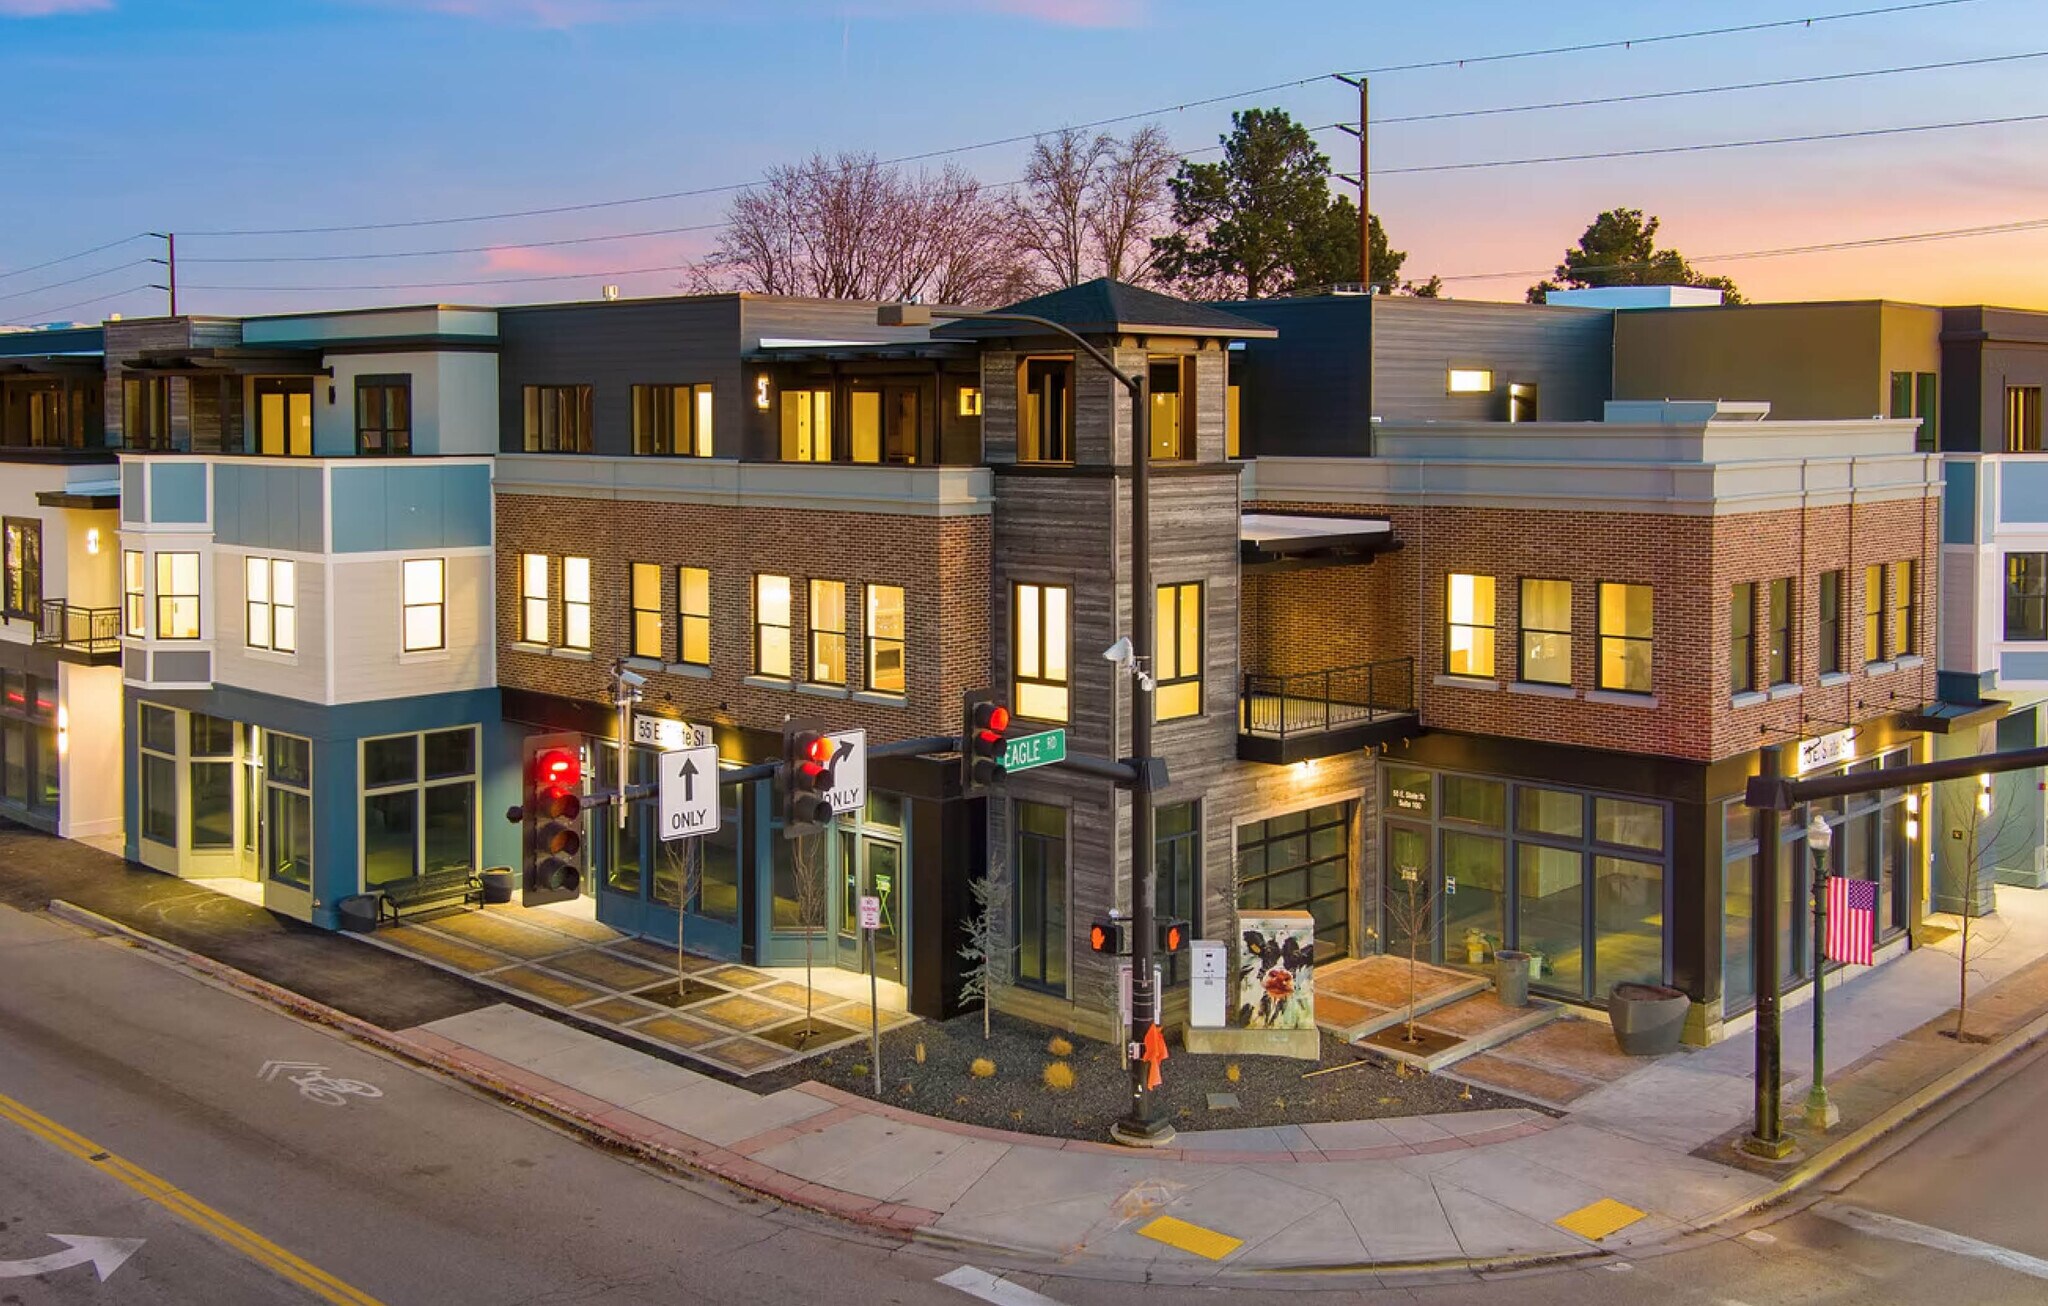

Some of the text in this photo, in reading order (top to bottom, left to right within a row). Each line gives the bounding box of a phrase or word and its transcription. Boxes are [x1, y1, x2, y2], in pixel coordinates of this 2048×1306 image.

[639, 720, 652, 739] 55
[694, 729, 705, 746] St
[1004, 735, 1058, 767] EAGLE RD
[671, 808, 708, 831] ONLY
